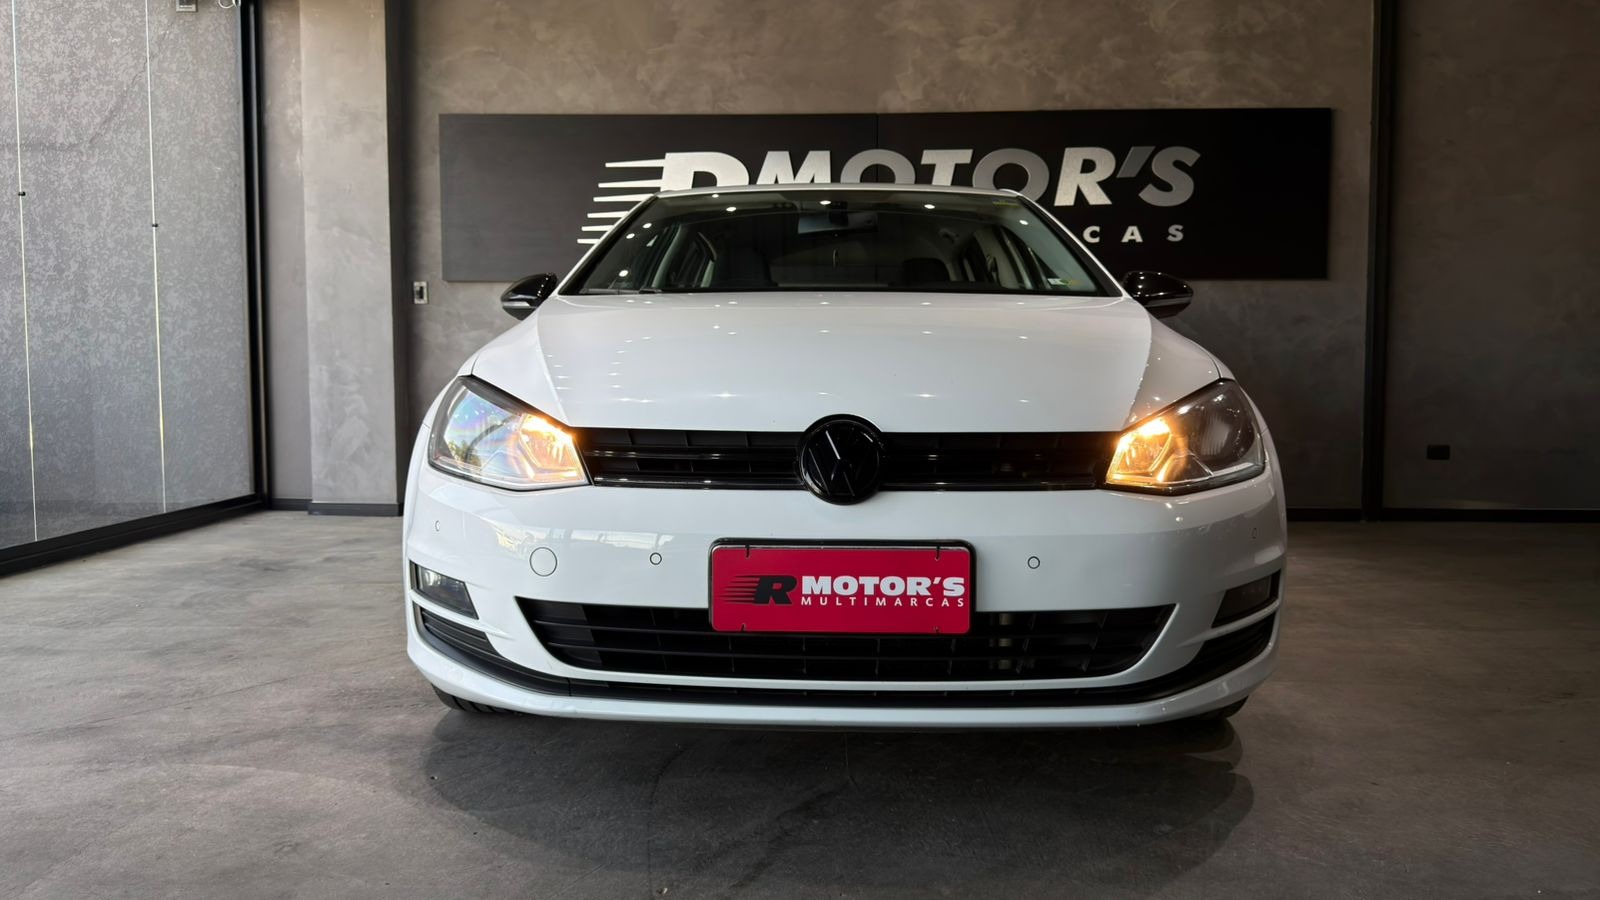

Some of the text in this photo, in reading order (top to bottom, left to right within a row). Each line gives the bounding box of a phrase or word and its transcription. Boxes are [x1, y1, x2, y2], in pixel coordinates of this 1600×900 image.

[757, 145, 1201, 207] MOTOR'S
[752, 575, 965, 605] R MOTOR'S
[801, 596, 965, 608] MULTIMARCAS
